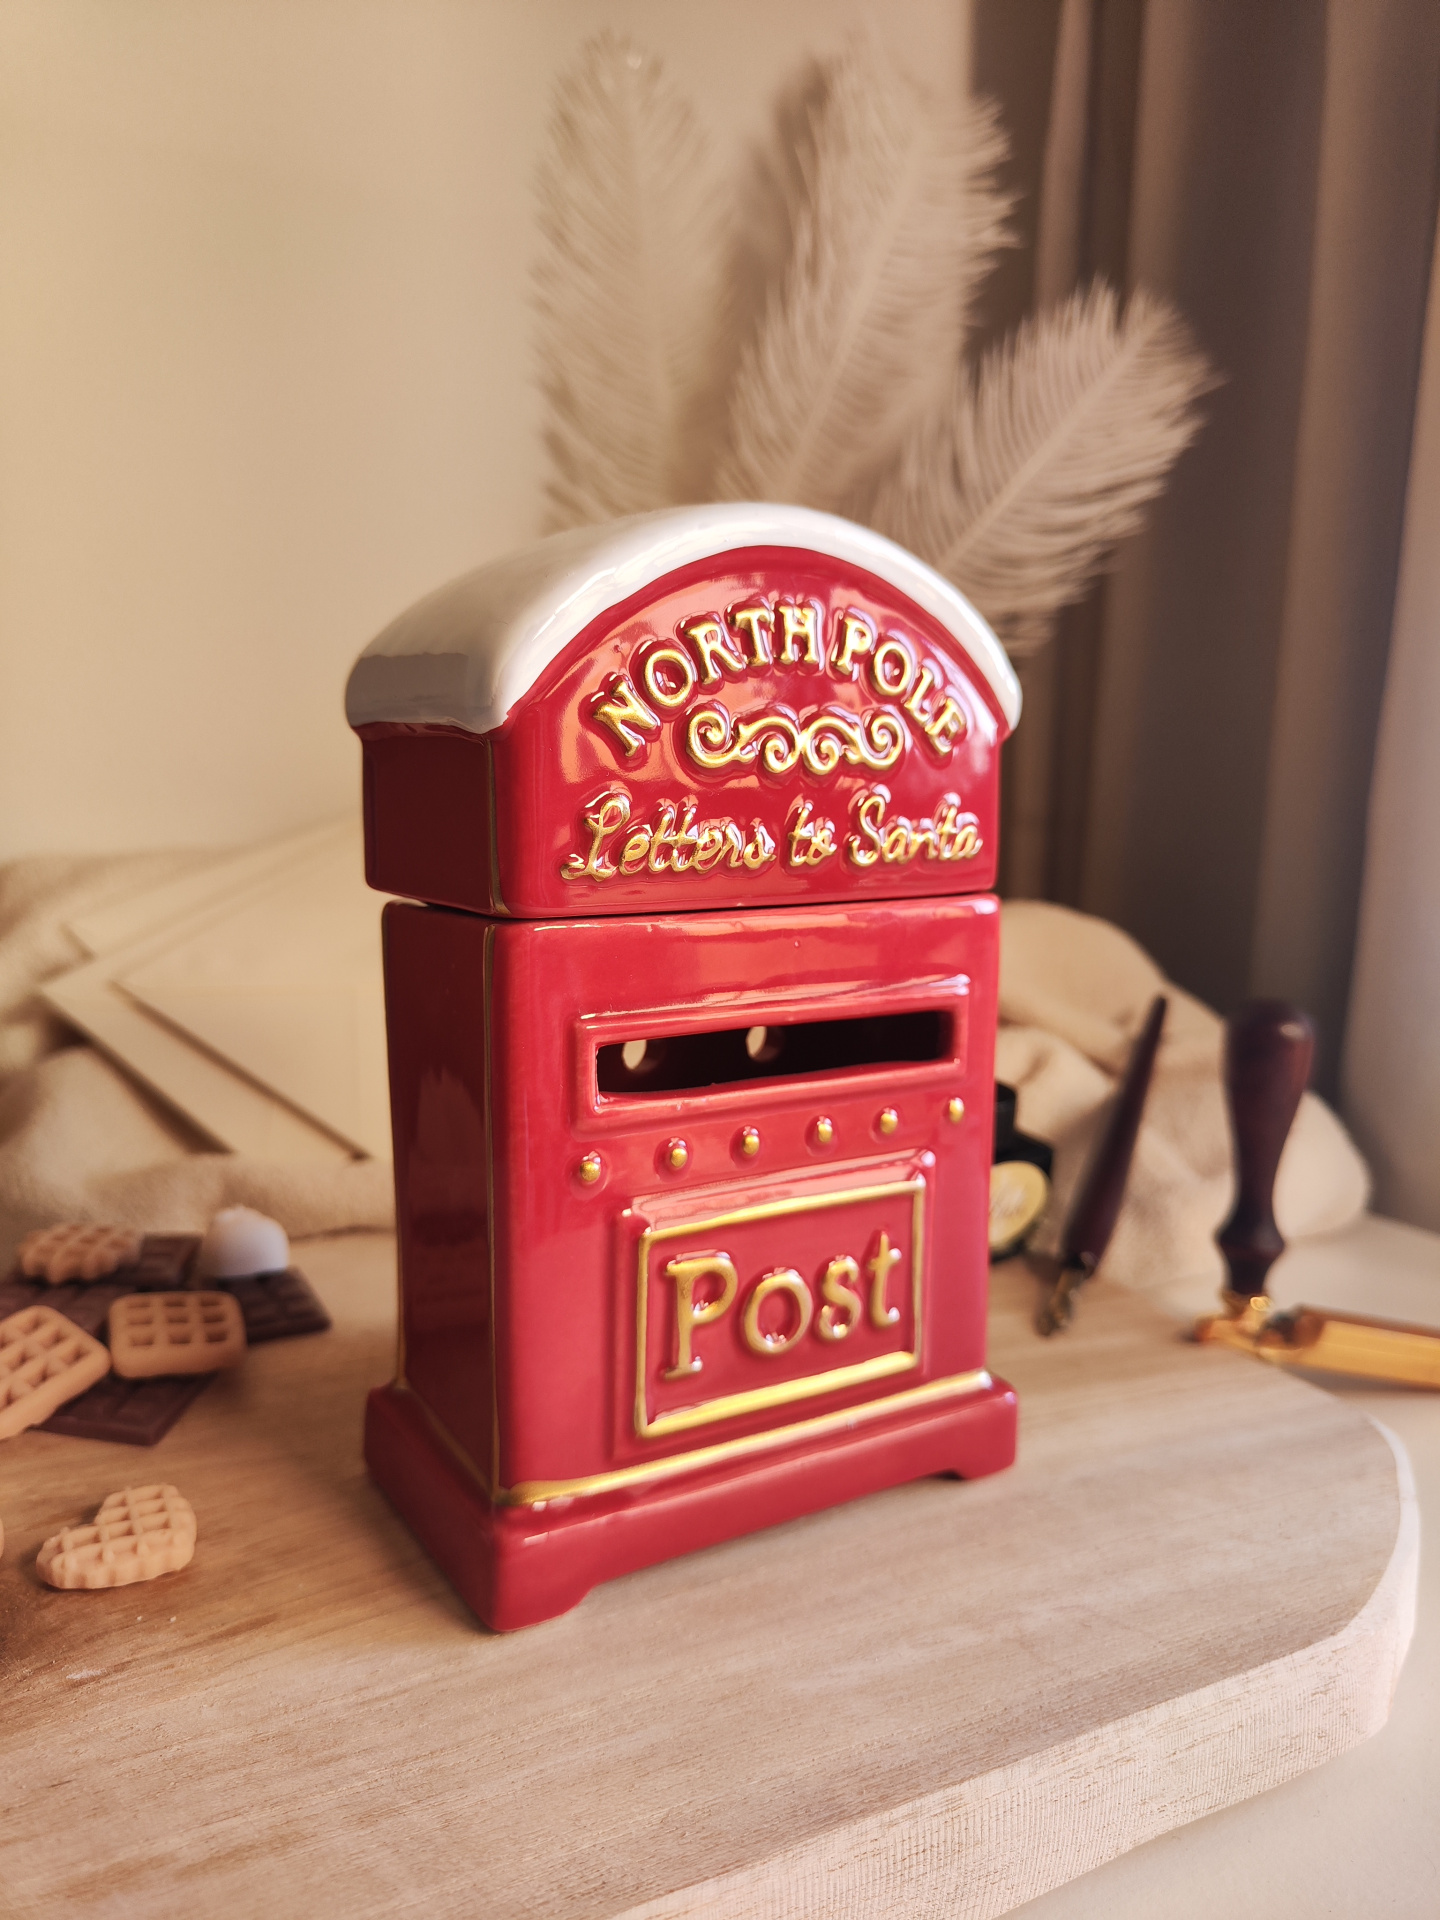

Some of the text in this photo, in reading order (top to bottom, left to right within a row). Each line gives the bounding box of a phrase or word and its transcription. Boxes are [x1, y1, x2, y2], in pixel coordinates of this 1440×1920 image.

[592, 603, 967, 757] NORTH POLE
[560, 790, 983, 880] Letters to Santa
[663, 1230, 902, 1379] Post
